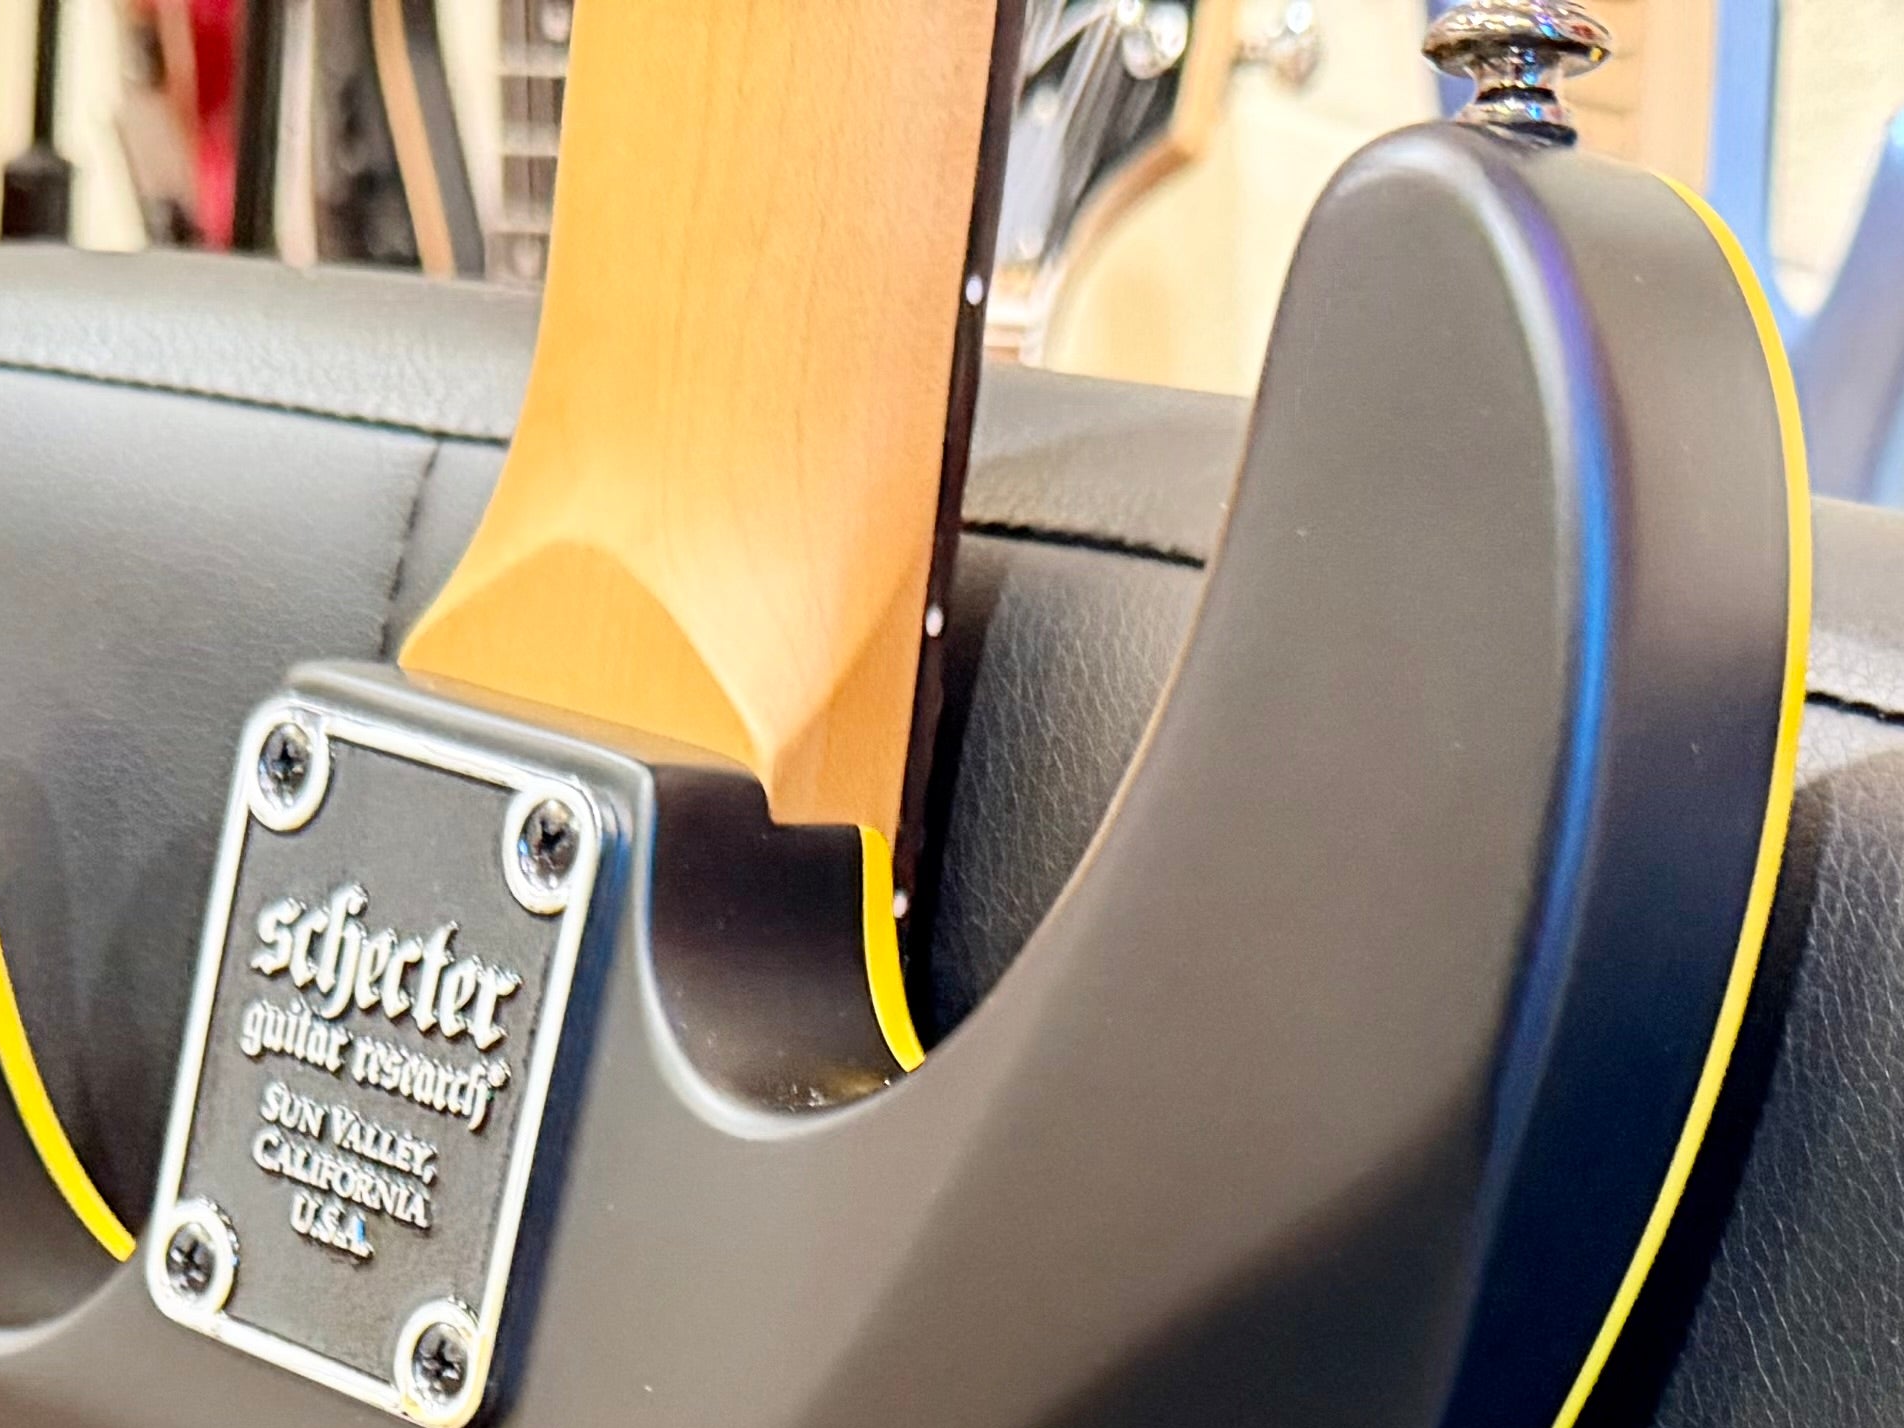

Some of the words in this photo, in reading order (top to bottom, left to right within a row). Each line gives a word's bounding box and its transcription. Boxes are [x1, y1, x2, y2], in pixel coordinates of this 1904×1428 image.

[250, 882, 523, 1050] schecter
[240, 997, 352, 1072] guitar
[252, 1124, 431, 1229] CALIFORNIA
[260, 1080, 330, 1138] SUN
[331, 1100, 438, 1185] VALLEY,
